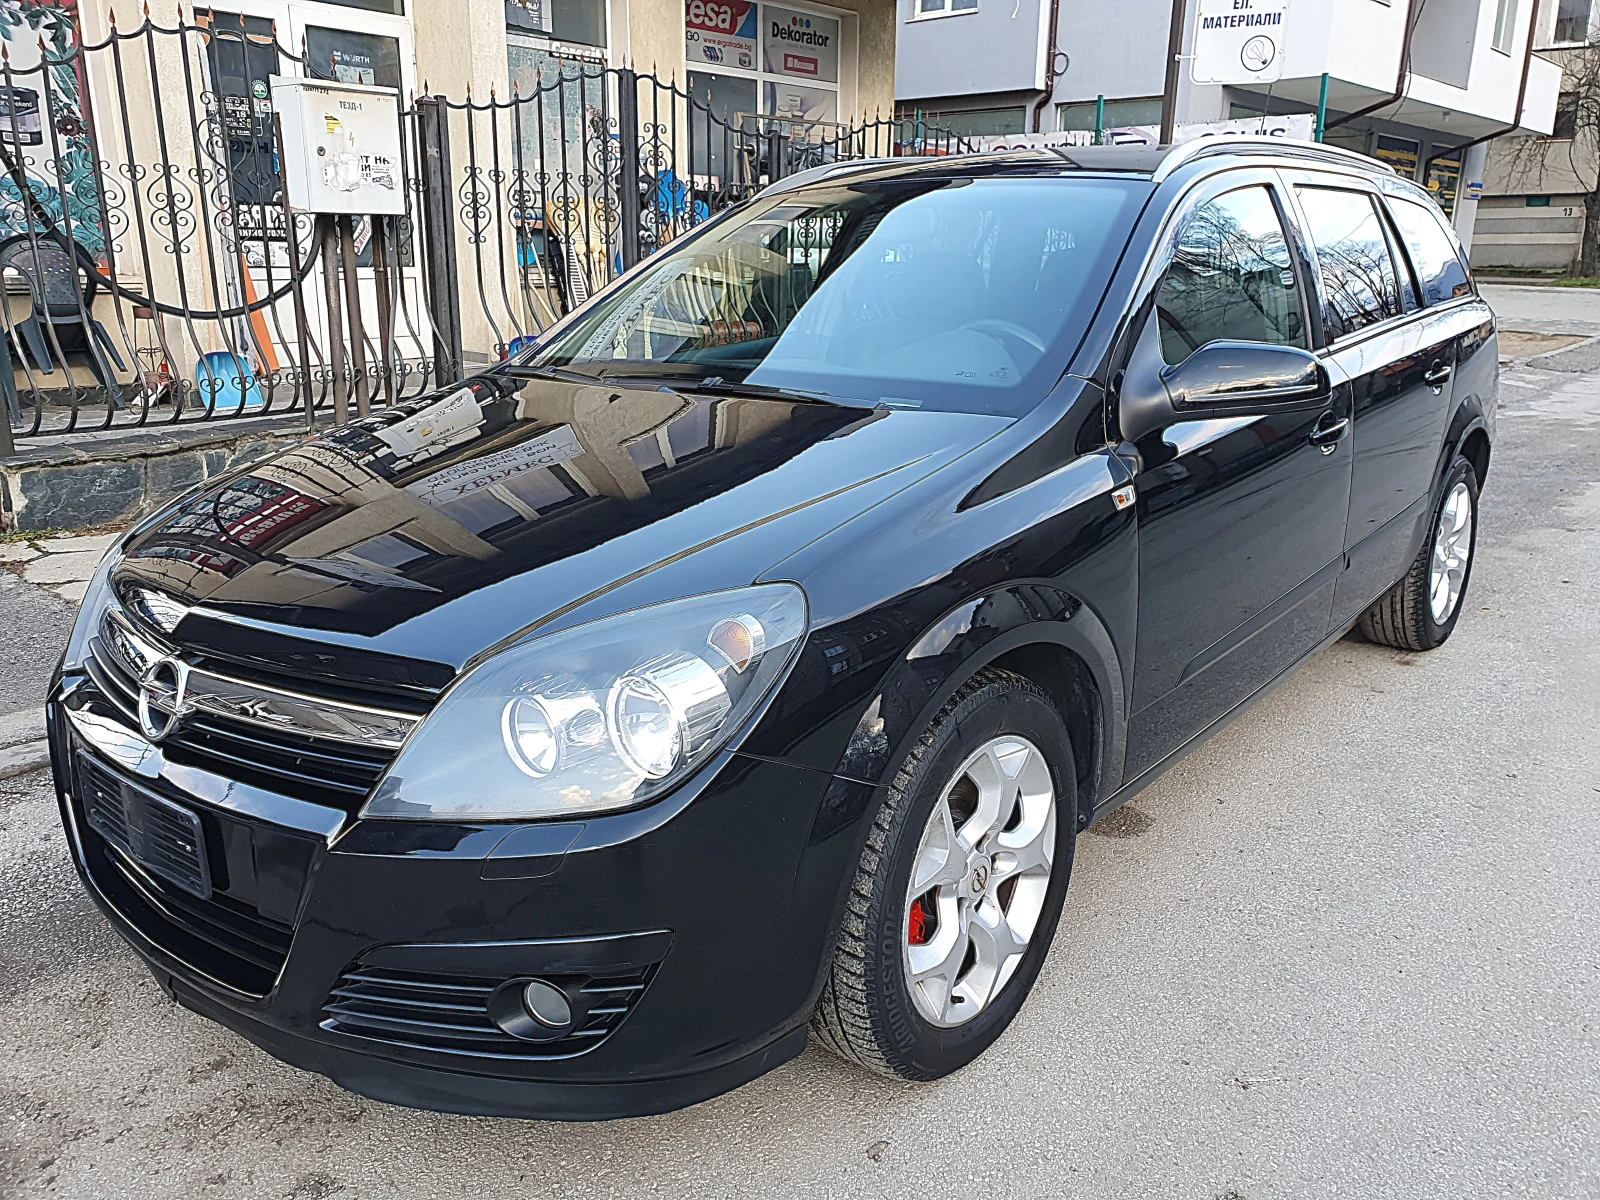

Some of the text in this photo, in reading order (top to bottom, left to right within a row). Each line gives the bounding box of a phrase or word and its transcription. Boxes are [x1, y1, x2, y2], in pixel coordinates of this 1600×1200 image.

[1233, 0, 1253, 10] ЕЛ.
[686, 0, 732, 29] esa
[1202, 12, 1282, 30] МАТЕРИАЛИ
[772, 21, 830, 47] Dekorator
[703, 37, 752, 52] www.ergotrade.bg
[1563, 207, 1573, 217] 13
